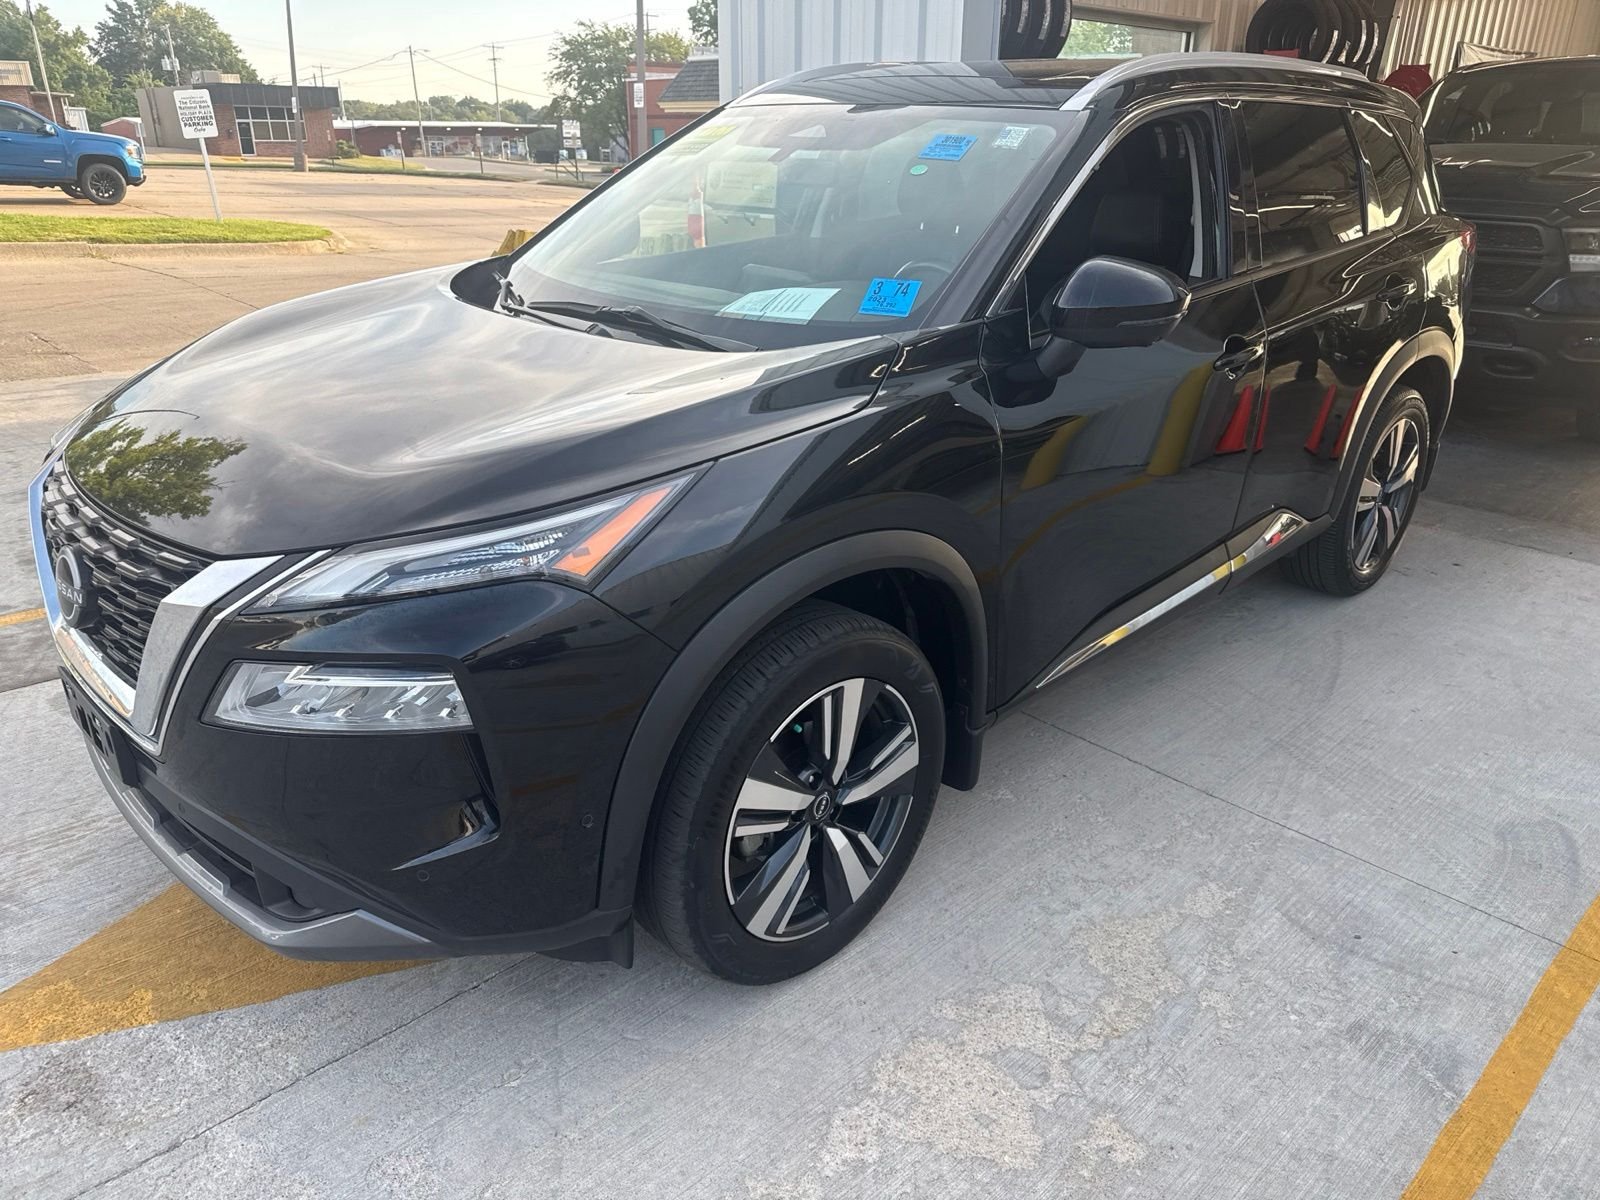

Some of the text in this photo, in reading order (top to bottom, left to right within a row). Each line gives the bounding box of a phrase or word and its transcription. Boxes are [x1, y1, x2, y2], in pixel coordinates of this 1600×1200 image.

[873, 281, 911, 297] 3 74
[57, 578, 82, 604] SSAN
